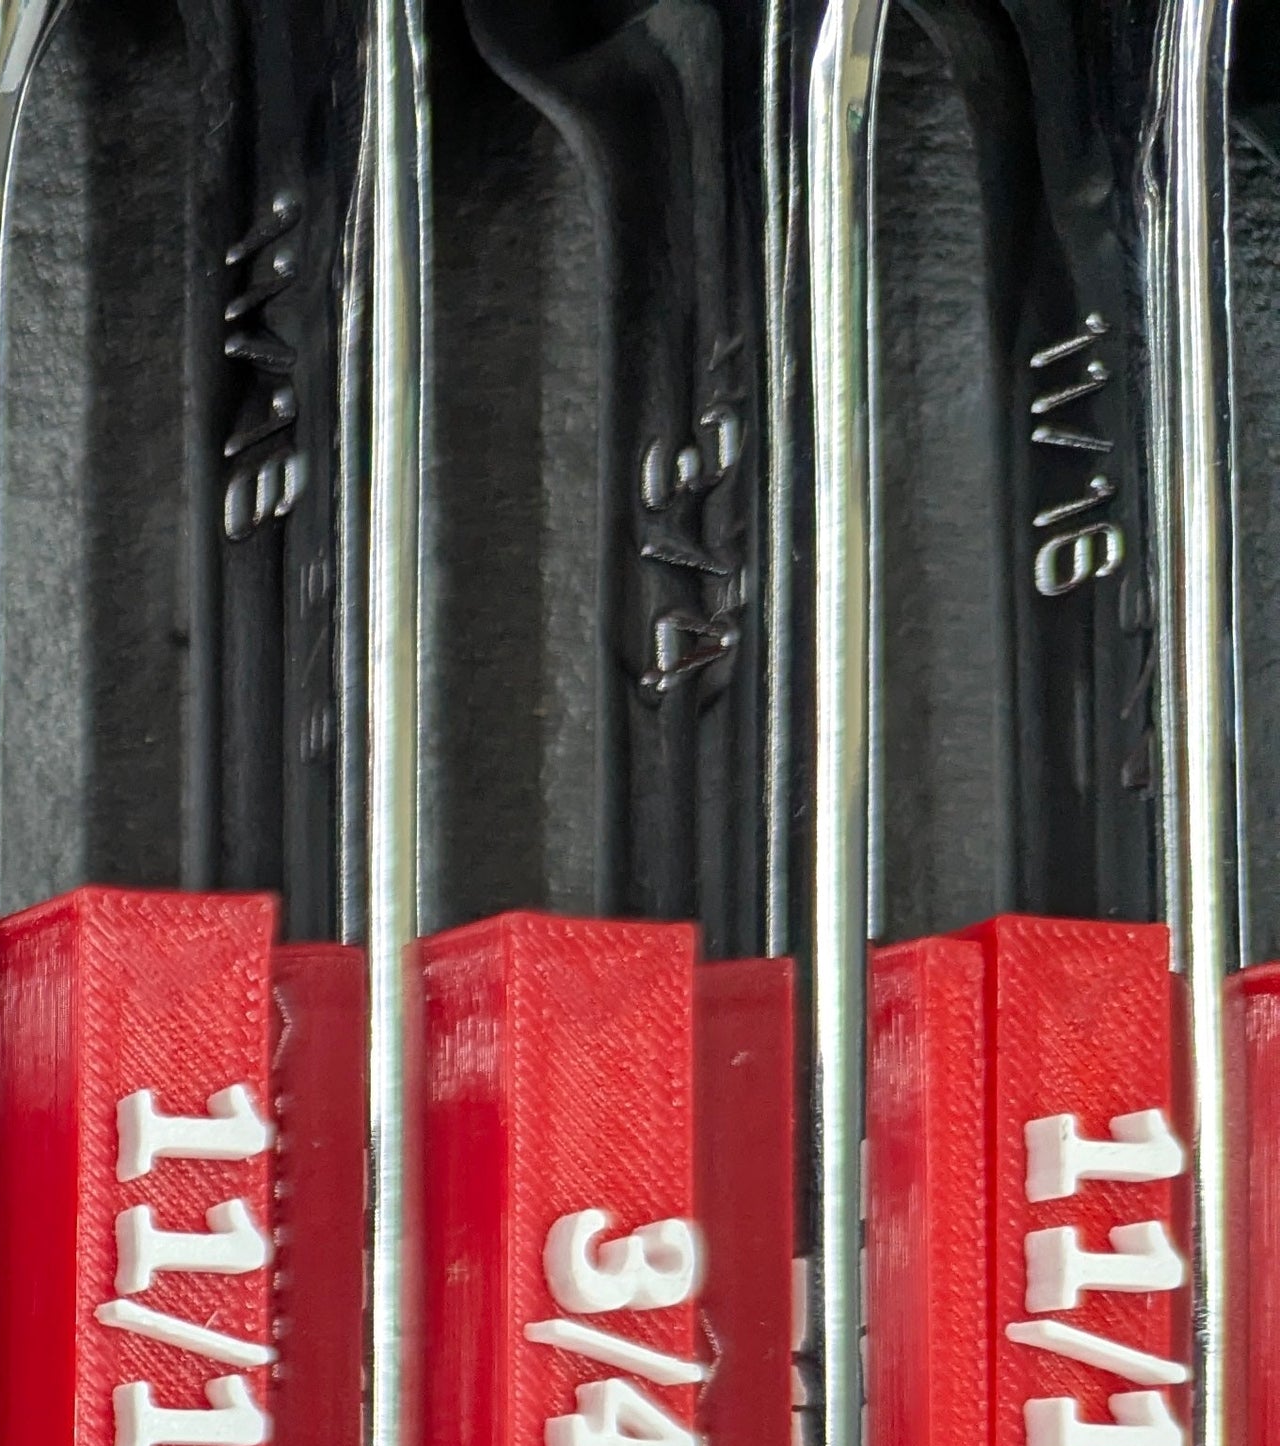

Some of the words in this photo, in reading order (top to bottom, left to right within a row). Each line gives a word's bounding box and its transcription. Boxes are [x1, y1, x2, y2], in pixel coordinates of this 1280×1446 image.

[222, 186, 310, 543] 11/16
[1029, 310, 1125, 597] 11/16
[639, 404, 740, 695] 3/4
